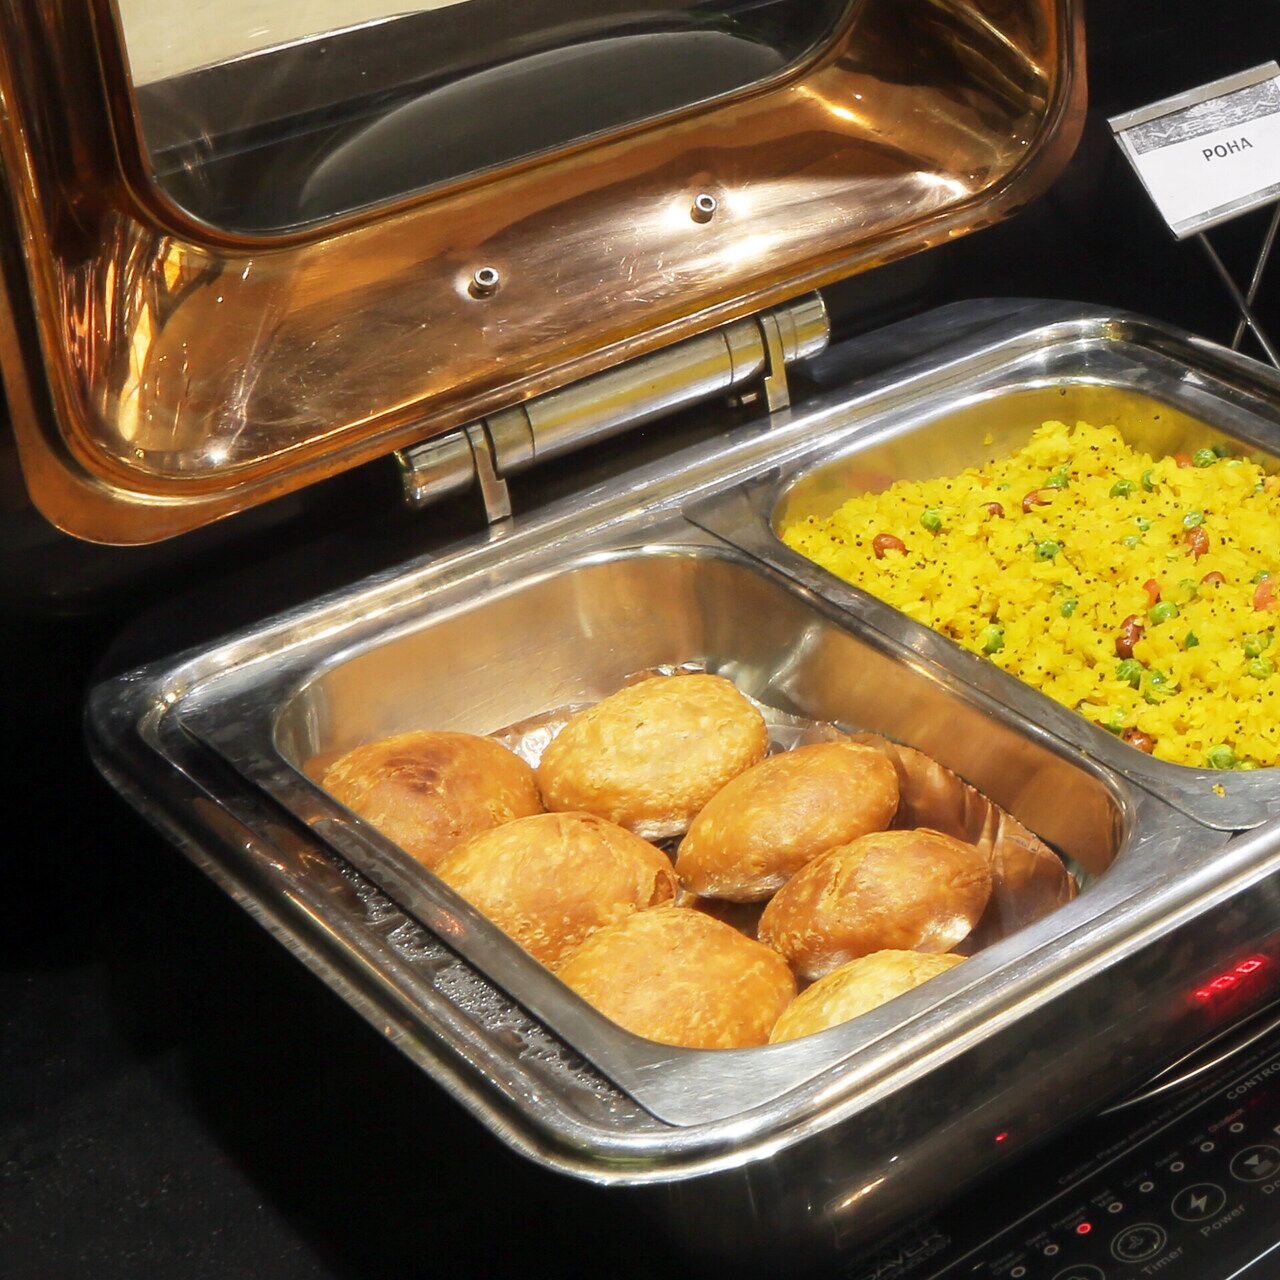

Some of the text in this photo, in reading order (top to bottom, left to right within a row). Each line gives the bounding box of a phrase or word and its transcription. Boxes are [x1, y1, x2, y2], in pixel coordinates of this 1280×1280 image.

[1147, 101, 1278, 138] VESTA
[1202, 137, 1254, 161] POHA
[1199, 1203, 1247, 1237] Power
[1140, 1245, 1184, 1277] Timer
